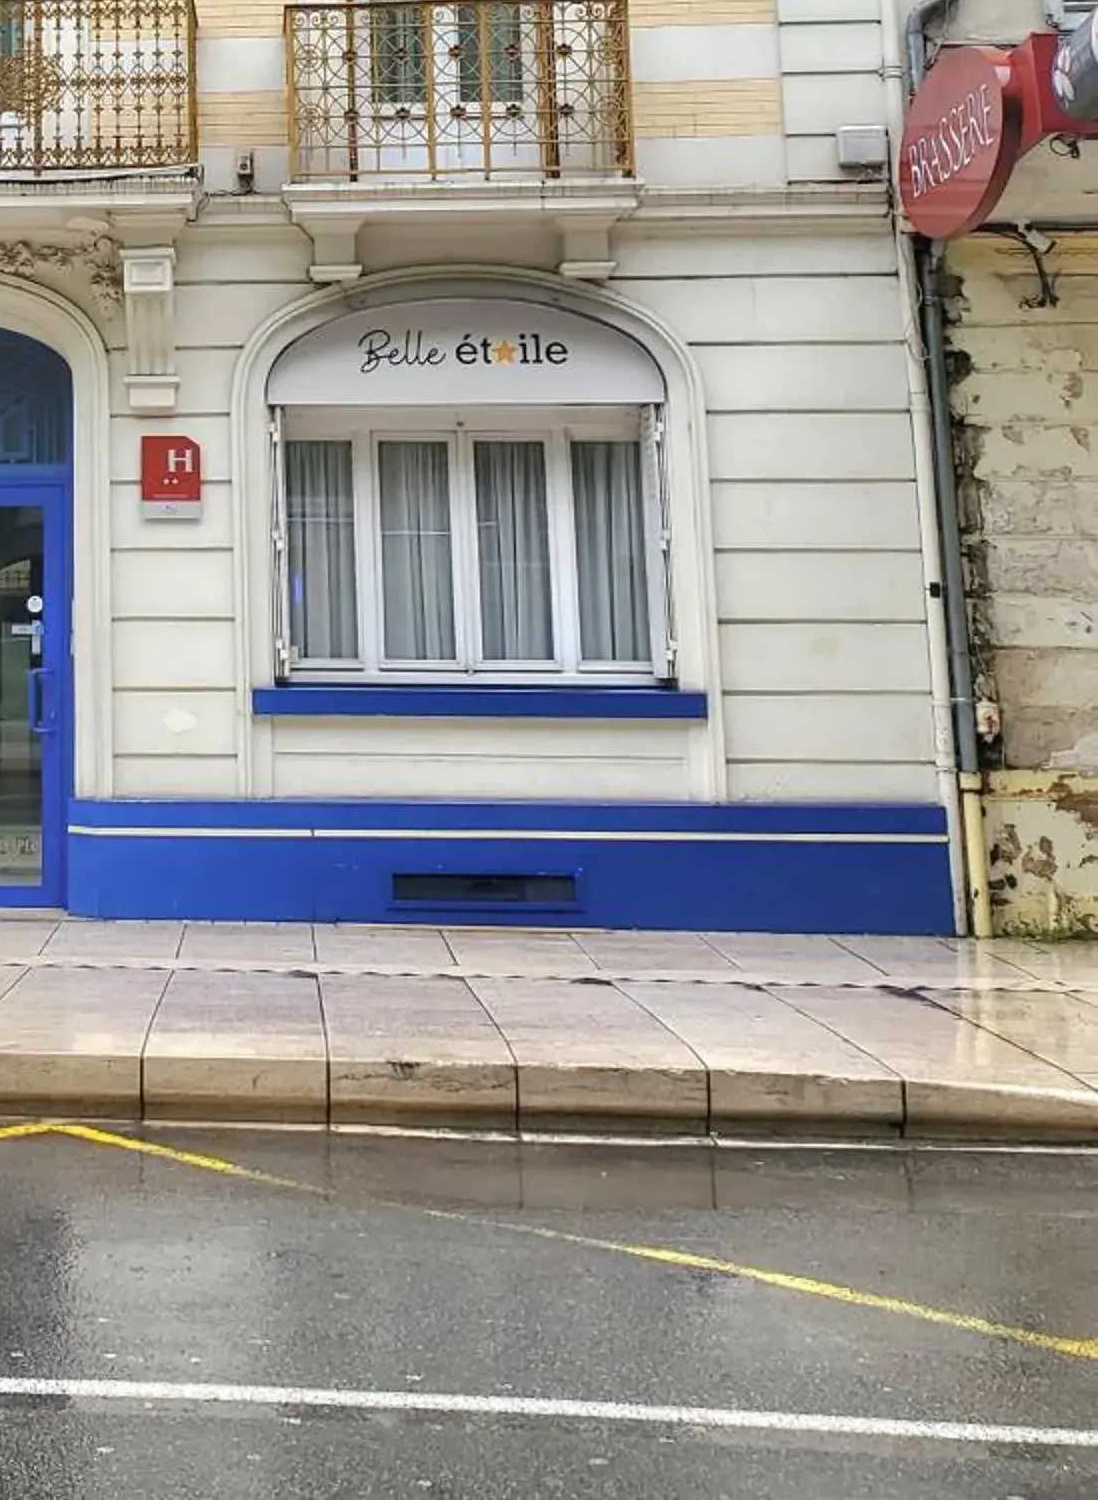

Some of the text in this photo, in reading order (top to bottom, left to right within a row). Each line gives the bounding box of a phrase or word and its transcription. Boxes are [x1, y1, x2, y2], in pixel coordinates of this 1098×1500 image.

[909, 84, 994, 198] BRASSERIE
[357, 329, 446, 373] Belle
[167, 449, 194, 473] H
